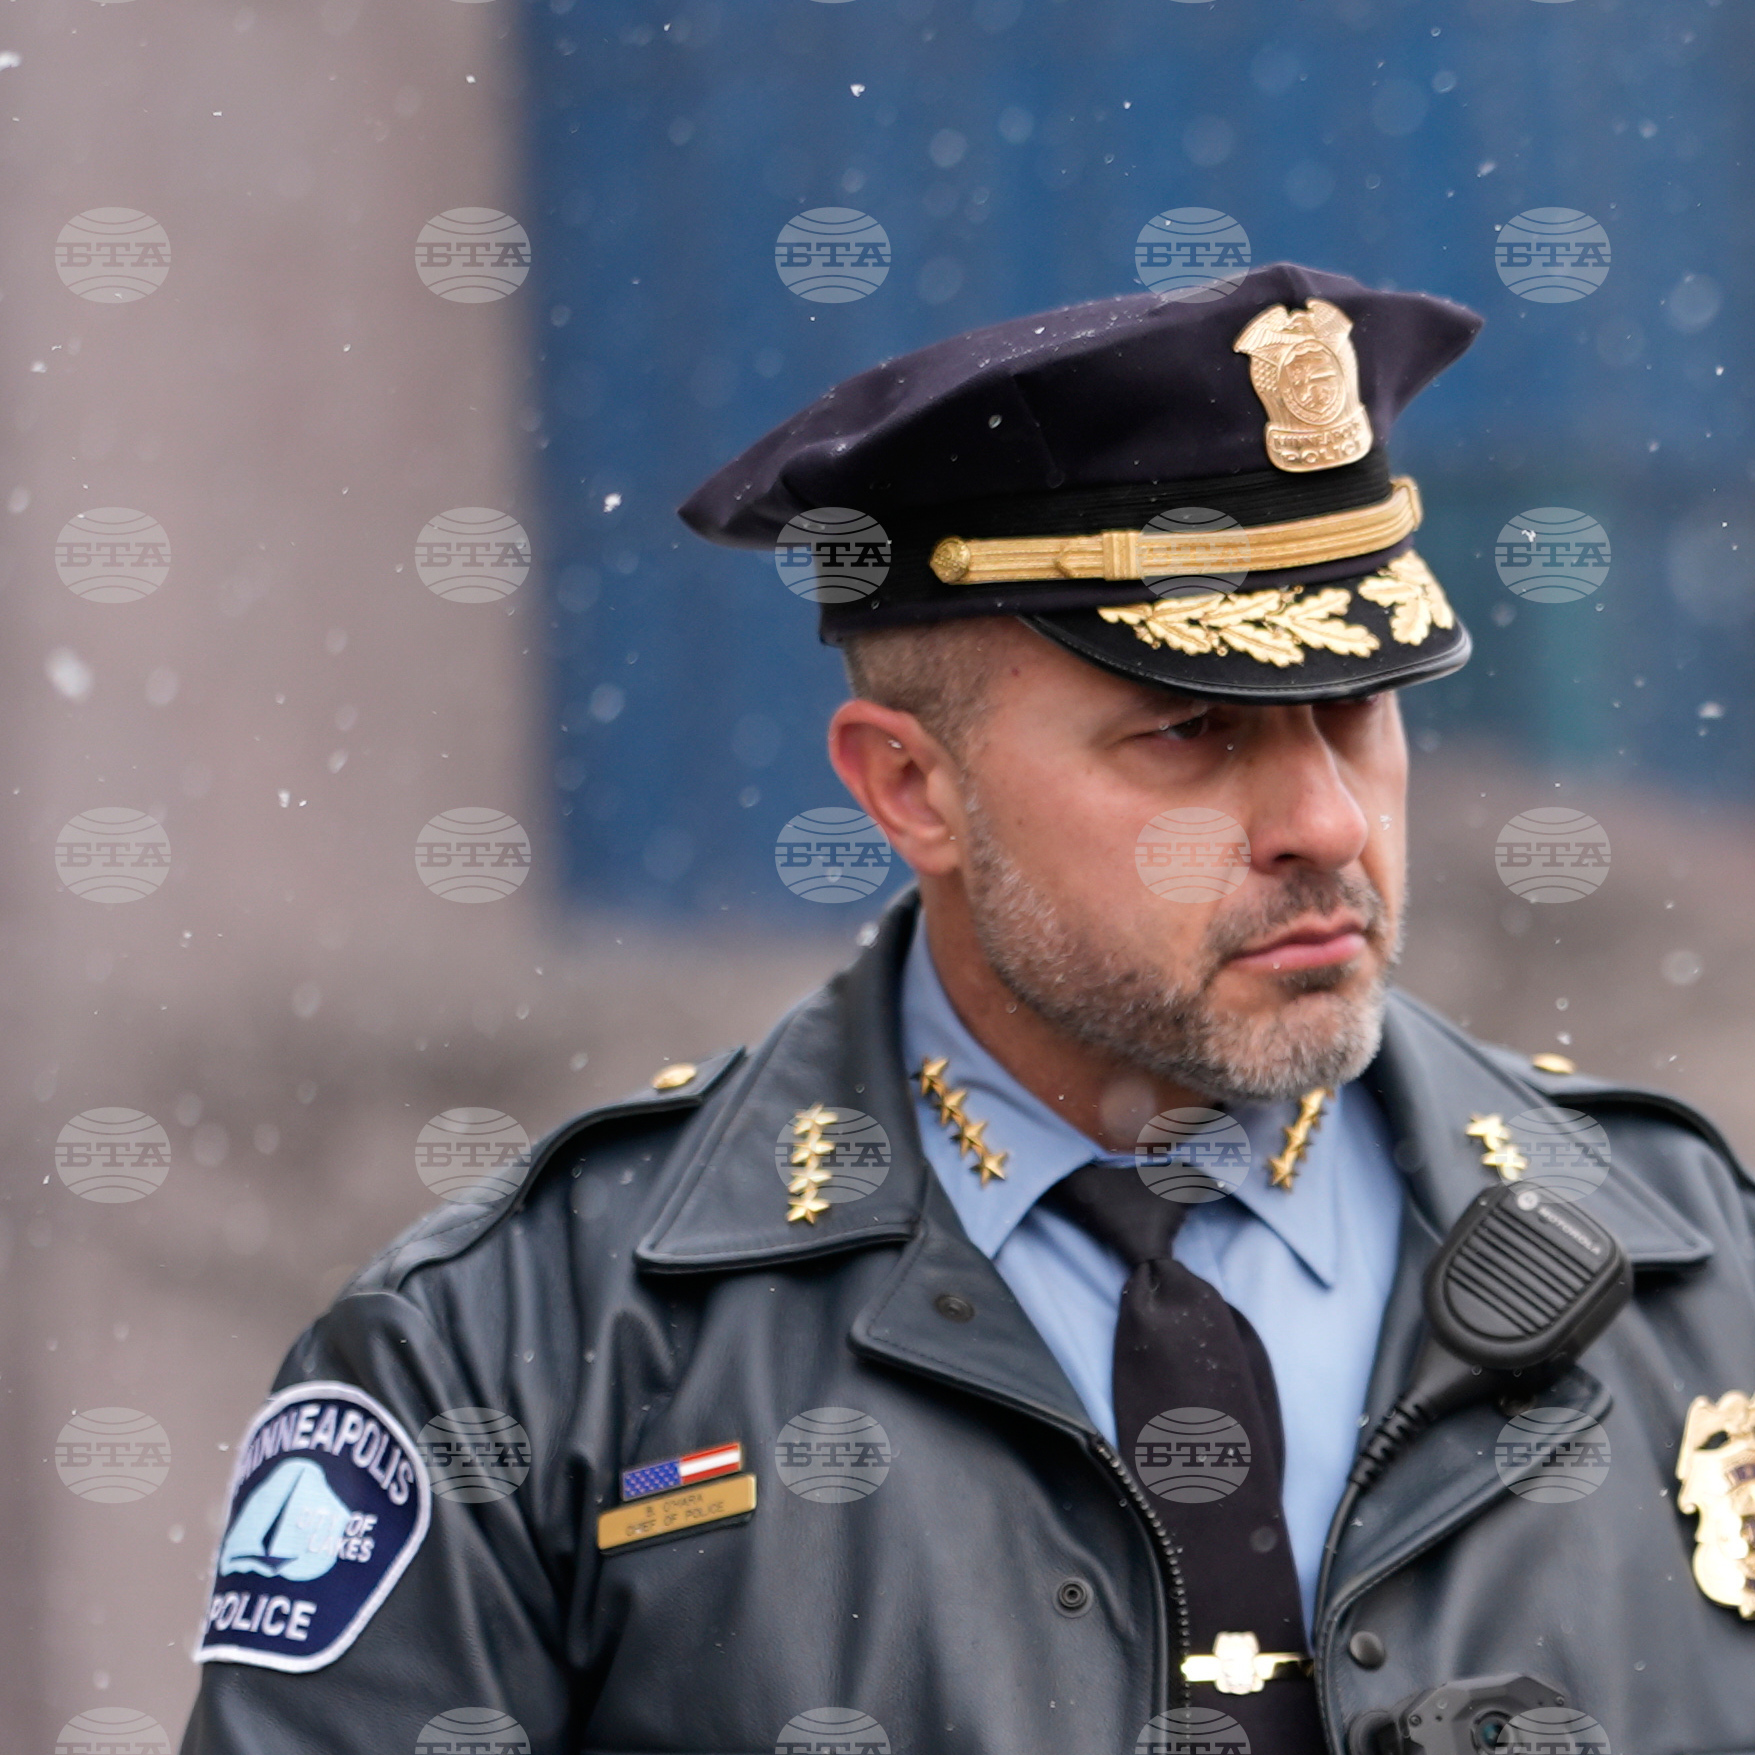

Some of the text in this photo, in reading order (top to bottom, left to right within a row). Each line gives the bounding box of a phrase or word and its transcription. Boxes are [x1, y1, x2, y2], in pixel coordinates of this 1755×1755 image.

[1537, 1205, 1603, 1256] MOTOROLA
[345, 1510, 378, 1537] OF
[663, 1513, 678, 1527] OF
[685, 1500, 725, 1522] POLICE
[207, 1588, 317, 1641] POLICE
